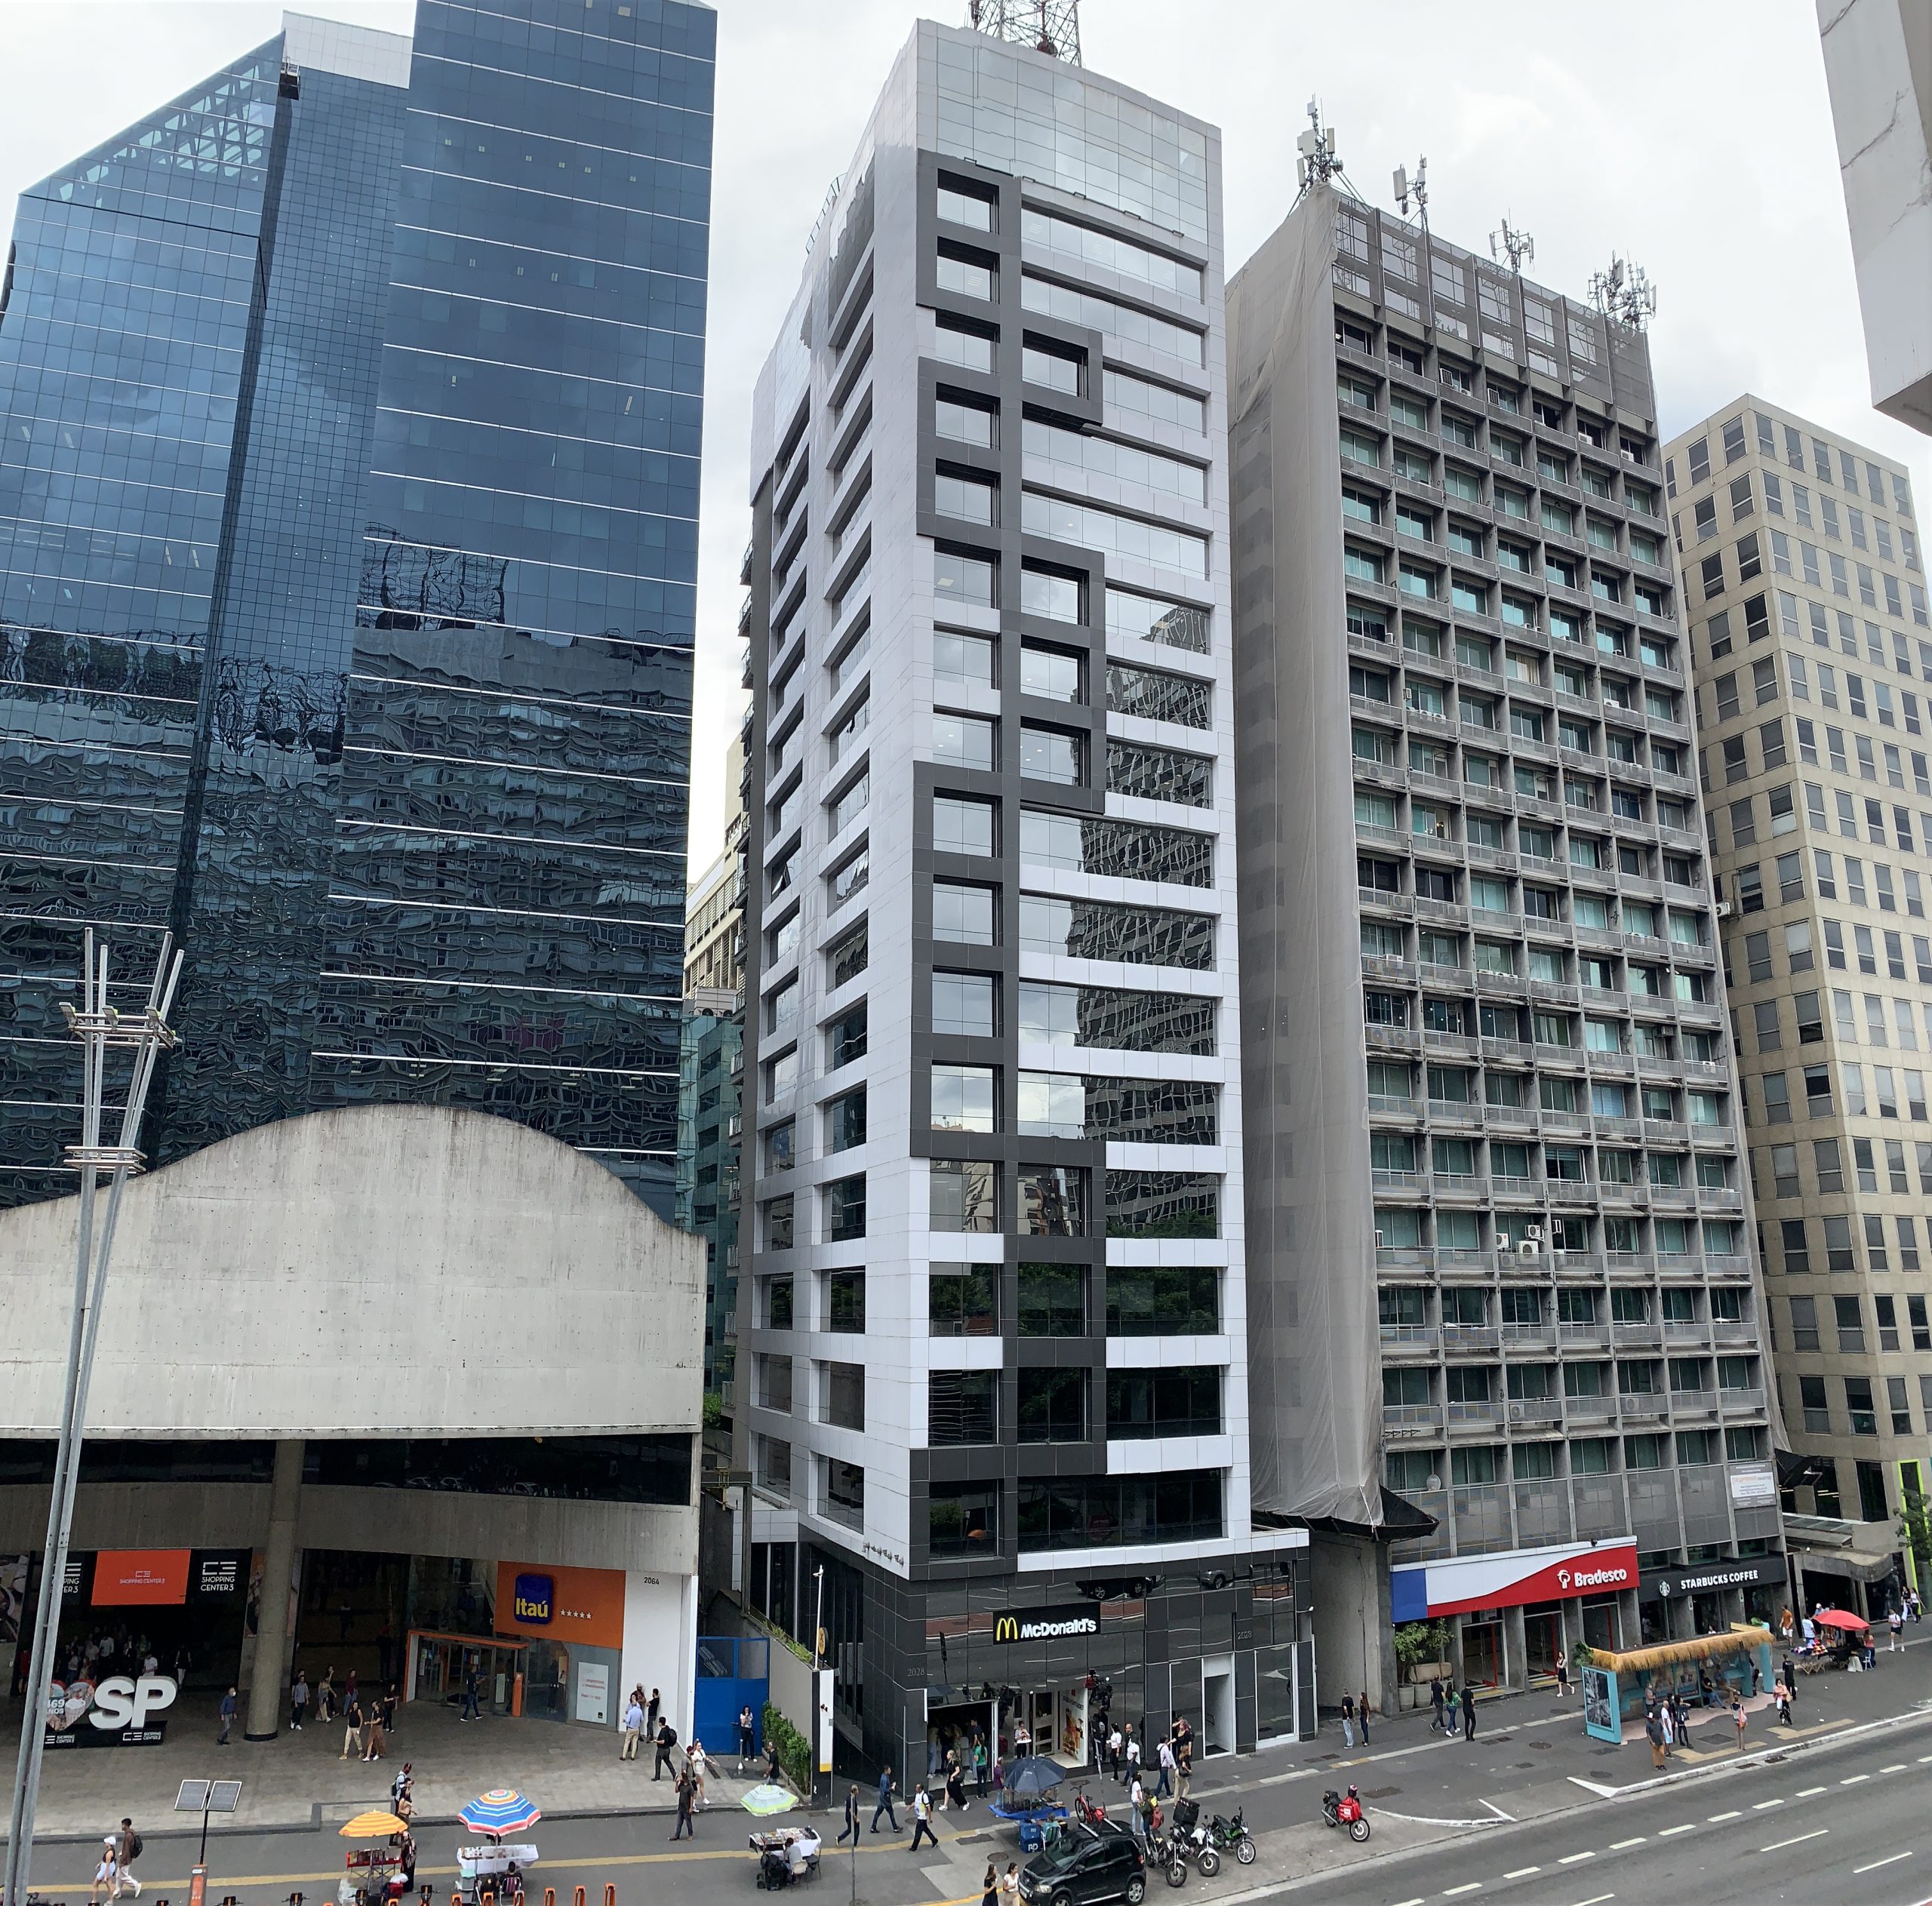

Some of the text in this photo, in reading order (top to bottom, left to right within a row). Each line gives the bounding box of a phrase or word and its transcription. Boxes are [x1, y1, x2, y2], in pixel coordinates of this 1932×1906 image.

[644, 1576, 660, 1585] 2064
[1574, 1568, 1627, 1588] Bradesco
[1680, 1569, 1758, 1590] STARBUCKS COFFEE
[515, 1597, 549, 1618] Itaú
[1020, 1619, 1097, 1639] McDonald's
[907, 1668, 925, 1677] 2028
[88, 1677, 177, 1729] SP
